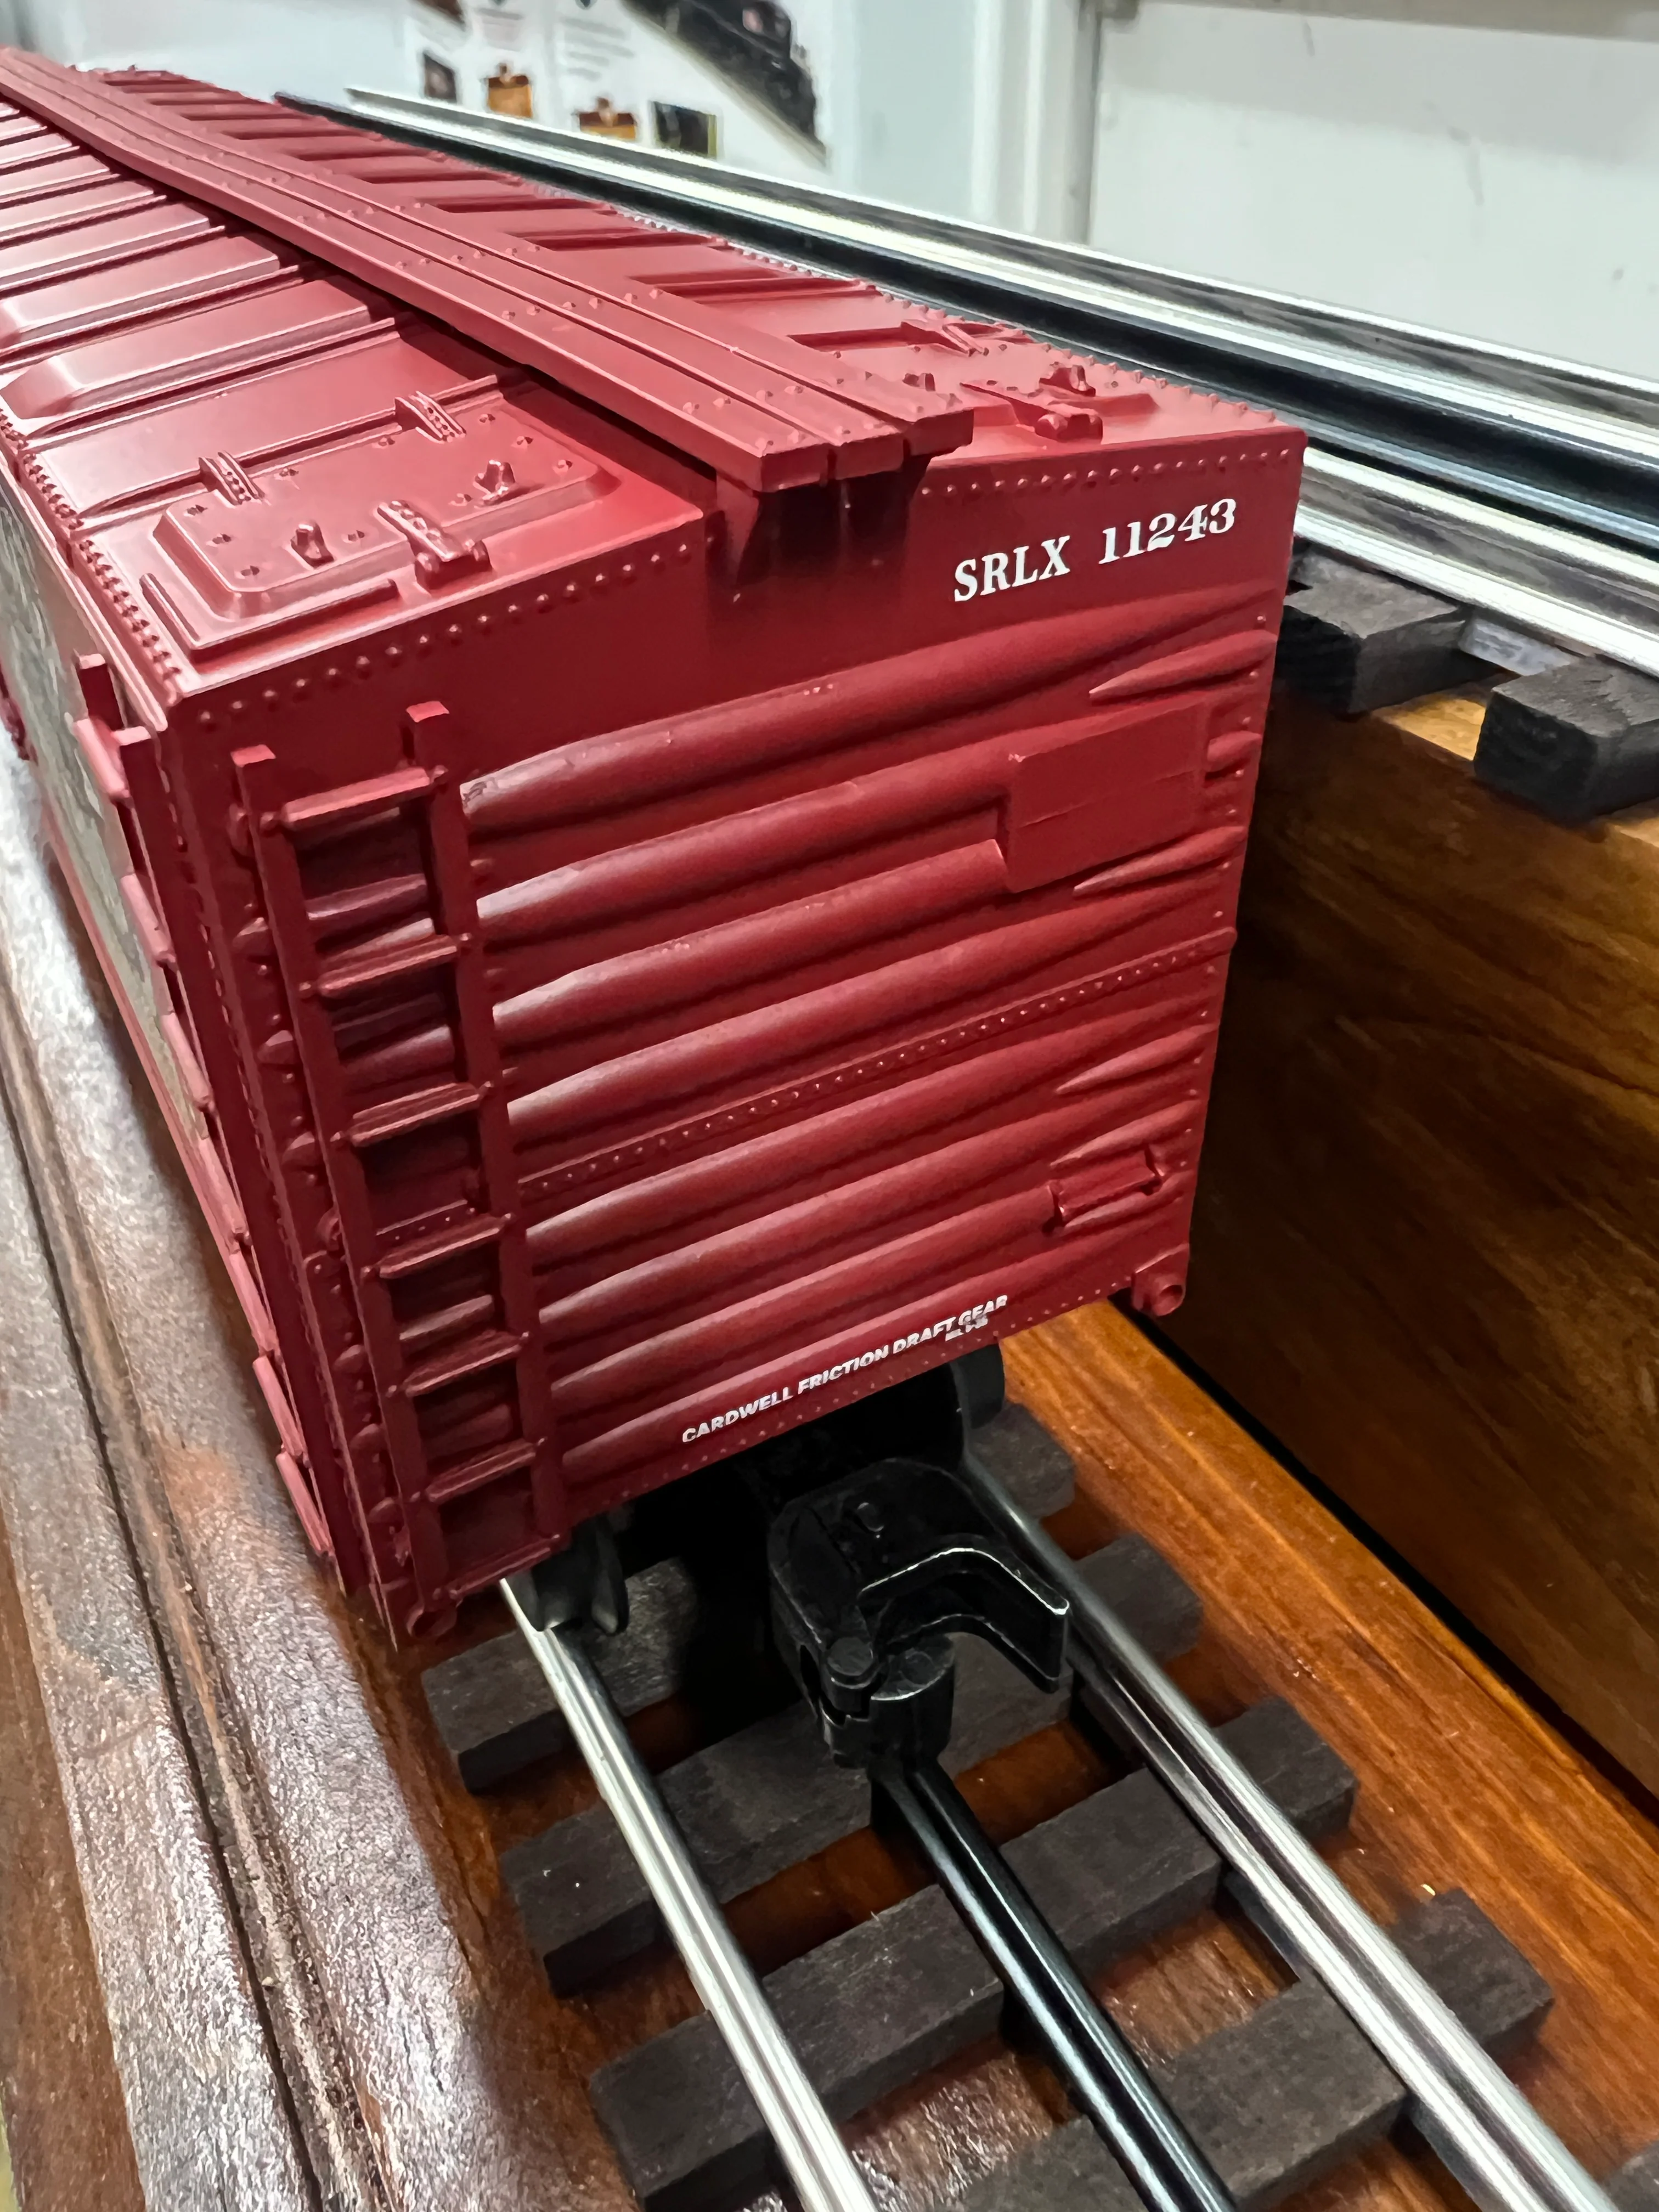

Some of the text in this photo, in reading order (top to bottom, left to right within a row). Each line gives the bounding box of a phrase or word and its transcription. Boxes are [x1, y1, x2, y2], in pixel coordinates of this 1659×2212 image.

[953, 498, 1237, 602] SRLX 11243
[681, 1386, 794, 1443] CARDWELL
[797, 1344, 889, 1395] FRICTION
[892, 1316, 957, 1355] DRAFT
[958, 1294, 1008, 1327] GEAR
